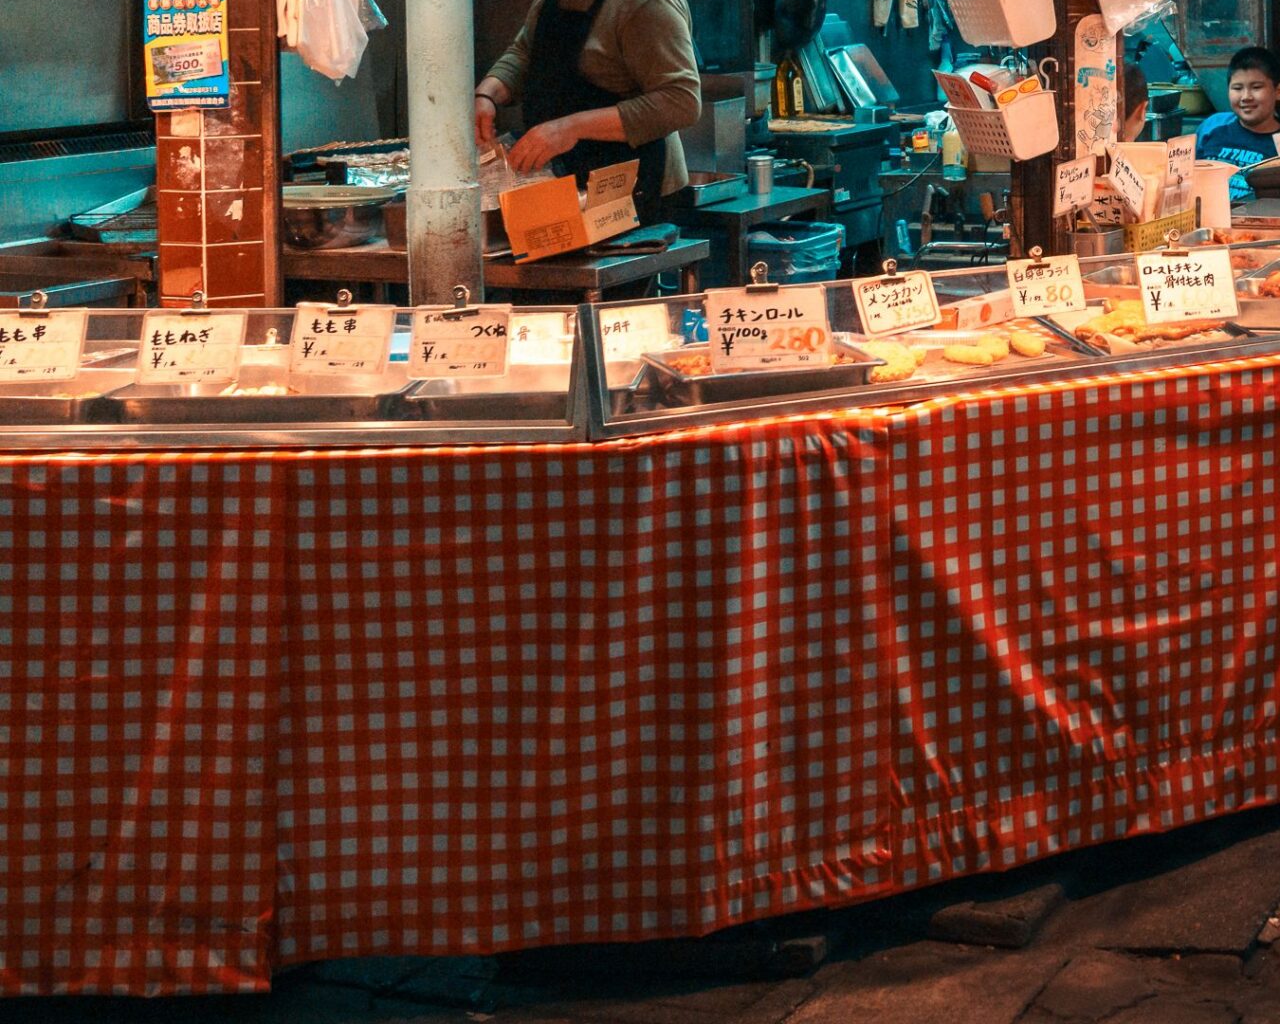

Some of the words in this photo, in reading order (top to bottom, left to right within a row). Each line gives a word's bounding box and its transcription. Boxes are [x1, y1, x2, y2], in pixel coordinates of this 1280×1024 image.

[1143, 262, 1202, 275] ローストチキン
[868, 282, 923, 307] メンチカツ
[1045, 284, 1073, 303] 80
[720, 307, 803, 324] チキンロール
[311, 318, 357, 334] もも串
[470, 325, 508, 338] つくね
[151, 327, 214, 346] ももねぎ
[769, 325, 826, 352] 280
